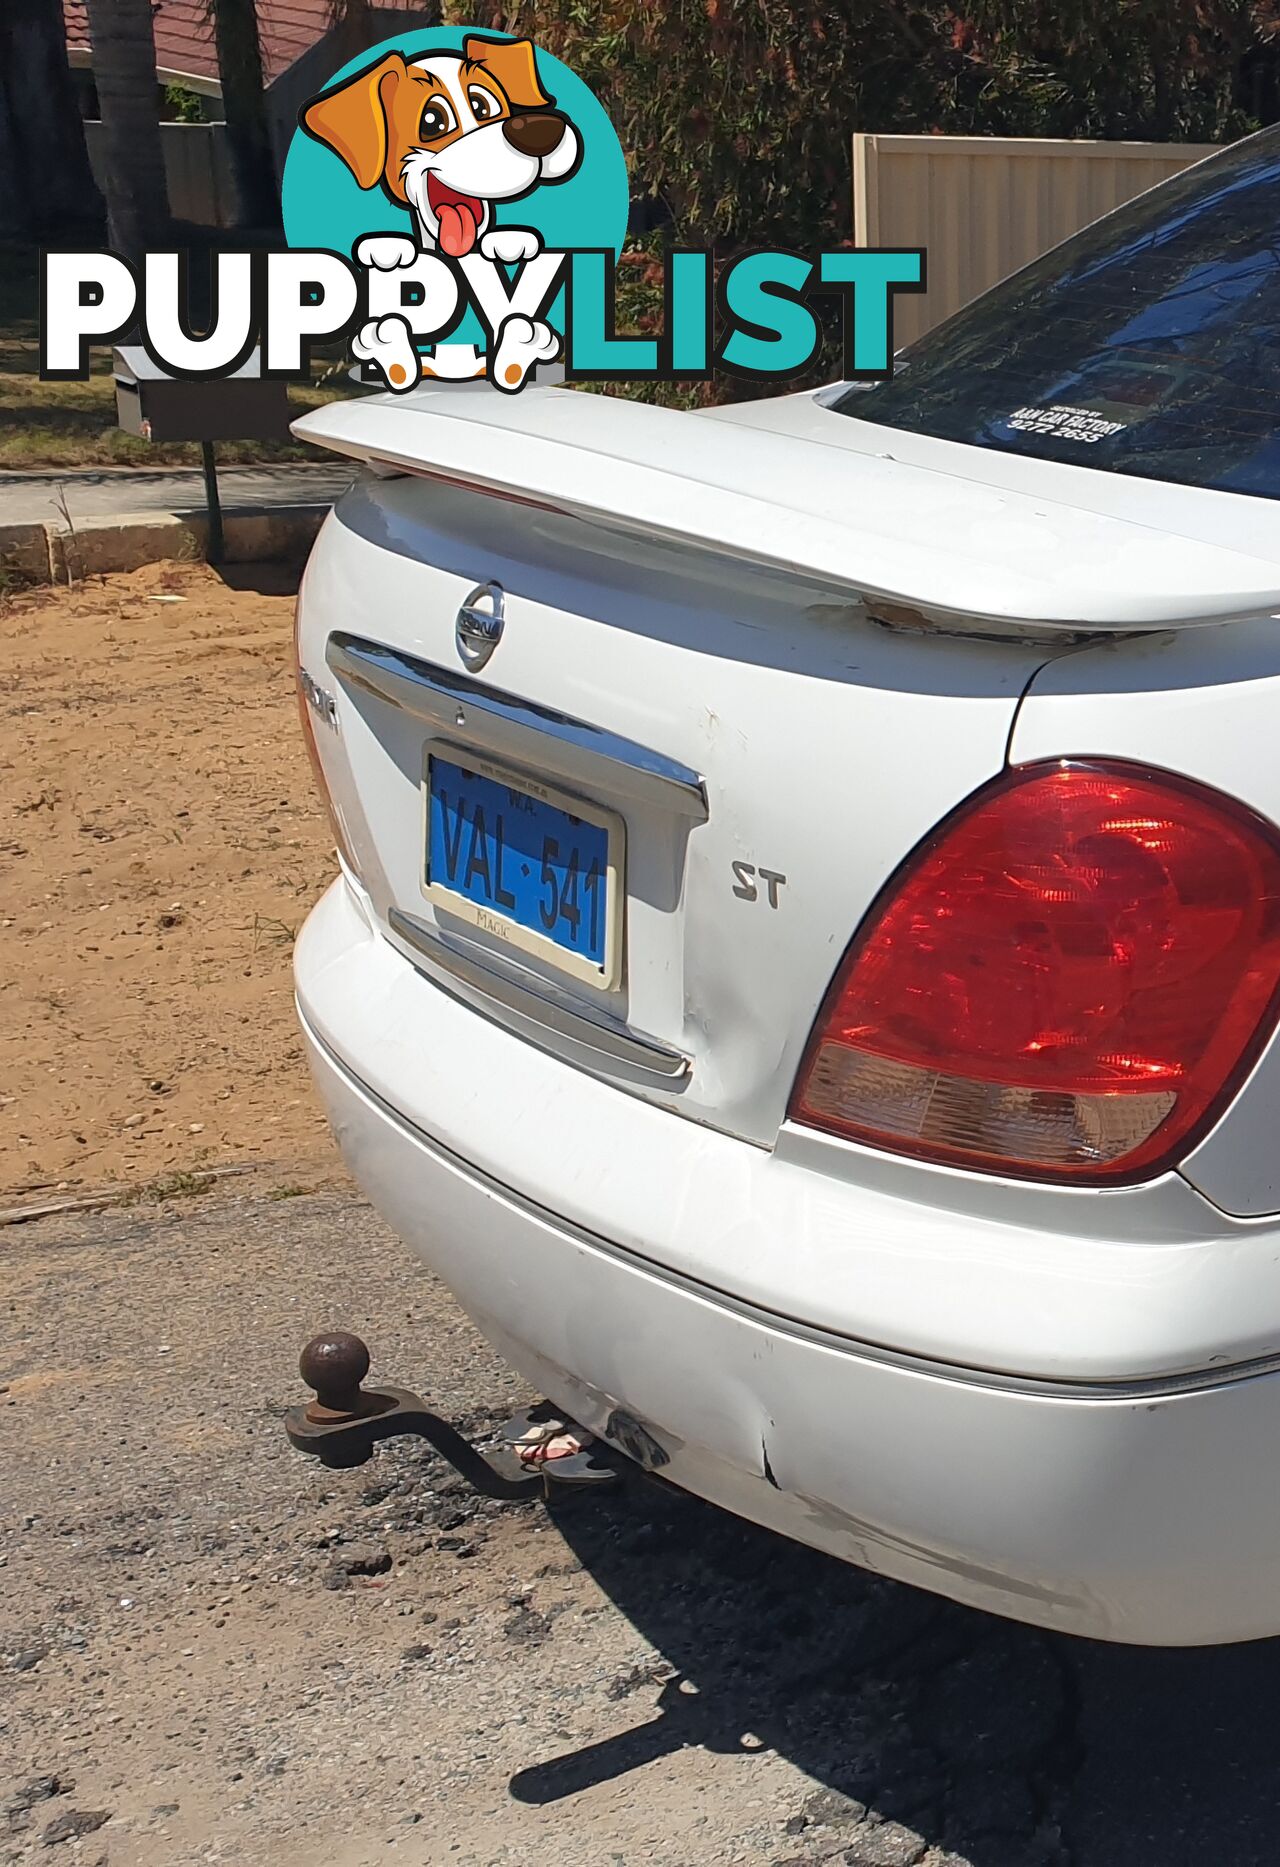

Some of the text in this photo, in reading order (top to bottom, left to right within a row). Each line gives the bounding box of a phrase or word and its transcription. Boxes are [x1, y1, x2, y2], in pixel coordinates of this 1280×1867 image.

[1006, 419, 1104, 443] 9272 2655
[1038, 411, 1070, 425] CAR
[1062, 415, 1128, 435] FACTORY
[731, 860, 786, 910] ST
